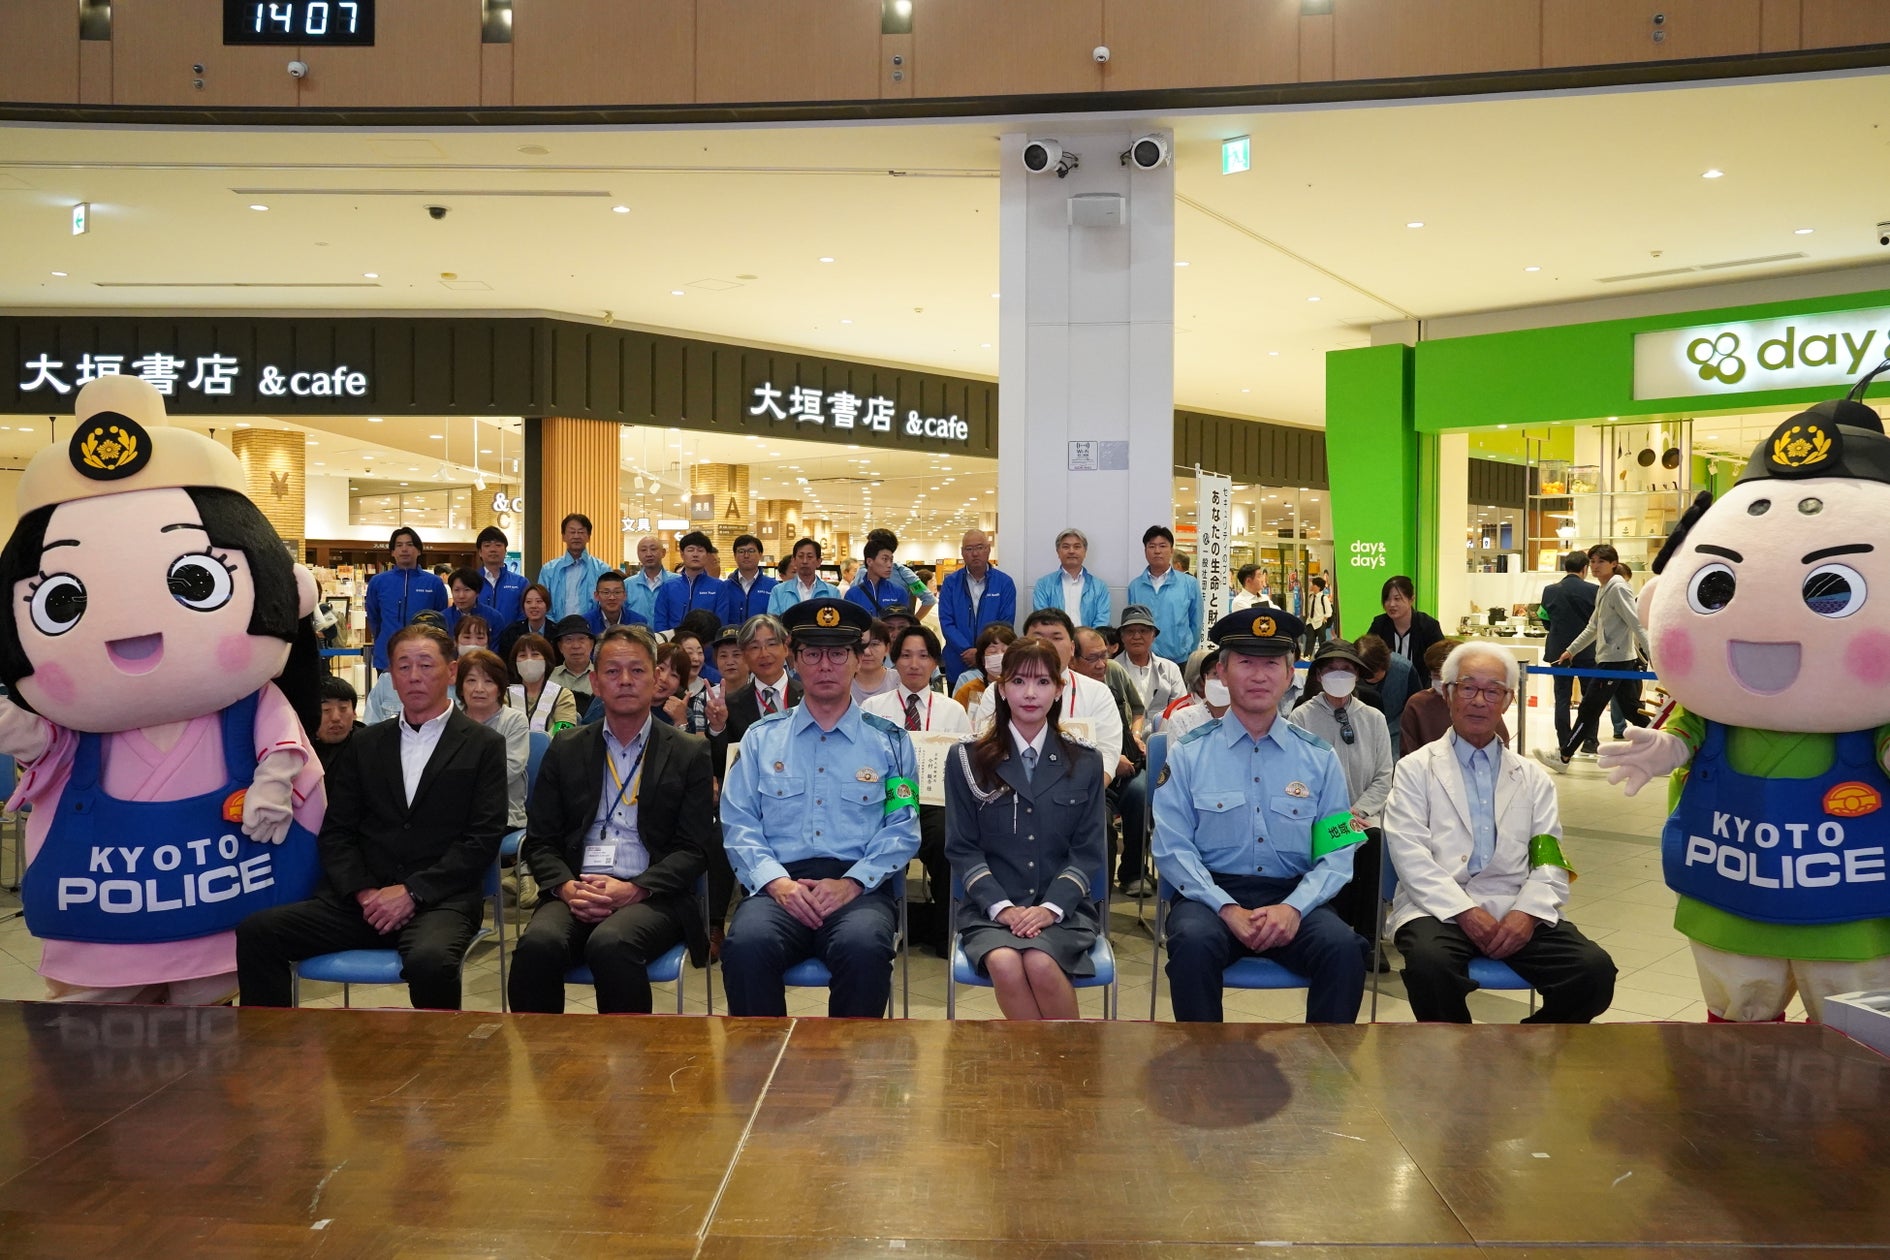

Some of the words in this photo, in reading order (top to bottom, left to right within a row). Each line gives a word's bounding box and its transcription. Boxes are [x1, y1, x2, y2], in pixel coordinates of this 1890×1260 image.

[1757, 326, 1890, 375] day
[20, 353, 240, 394] 大垣書店
[258, 365, 367, 396] &cafe
[750, 381, 895, 432] 大垣書店
[905, 410, 968, 440] &cafe
[621, 517, 651, 532] 文具
[726, 497, 740, 518] A
[786, 523, 796, 540] B
[1350, 540, 1386, 555] day&
[1350, 554, 1386, 569] day's
[1328, 822, 1350, 839] 地域
[1712, 810, 1845, 849] KYOTO
[89, 834, 240, 874] KYOTO
[1685, 846, 1886, 889] POLICE
[58, 852, 276, 914] POLICE
